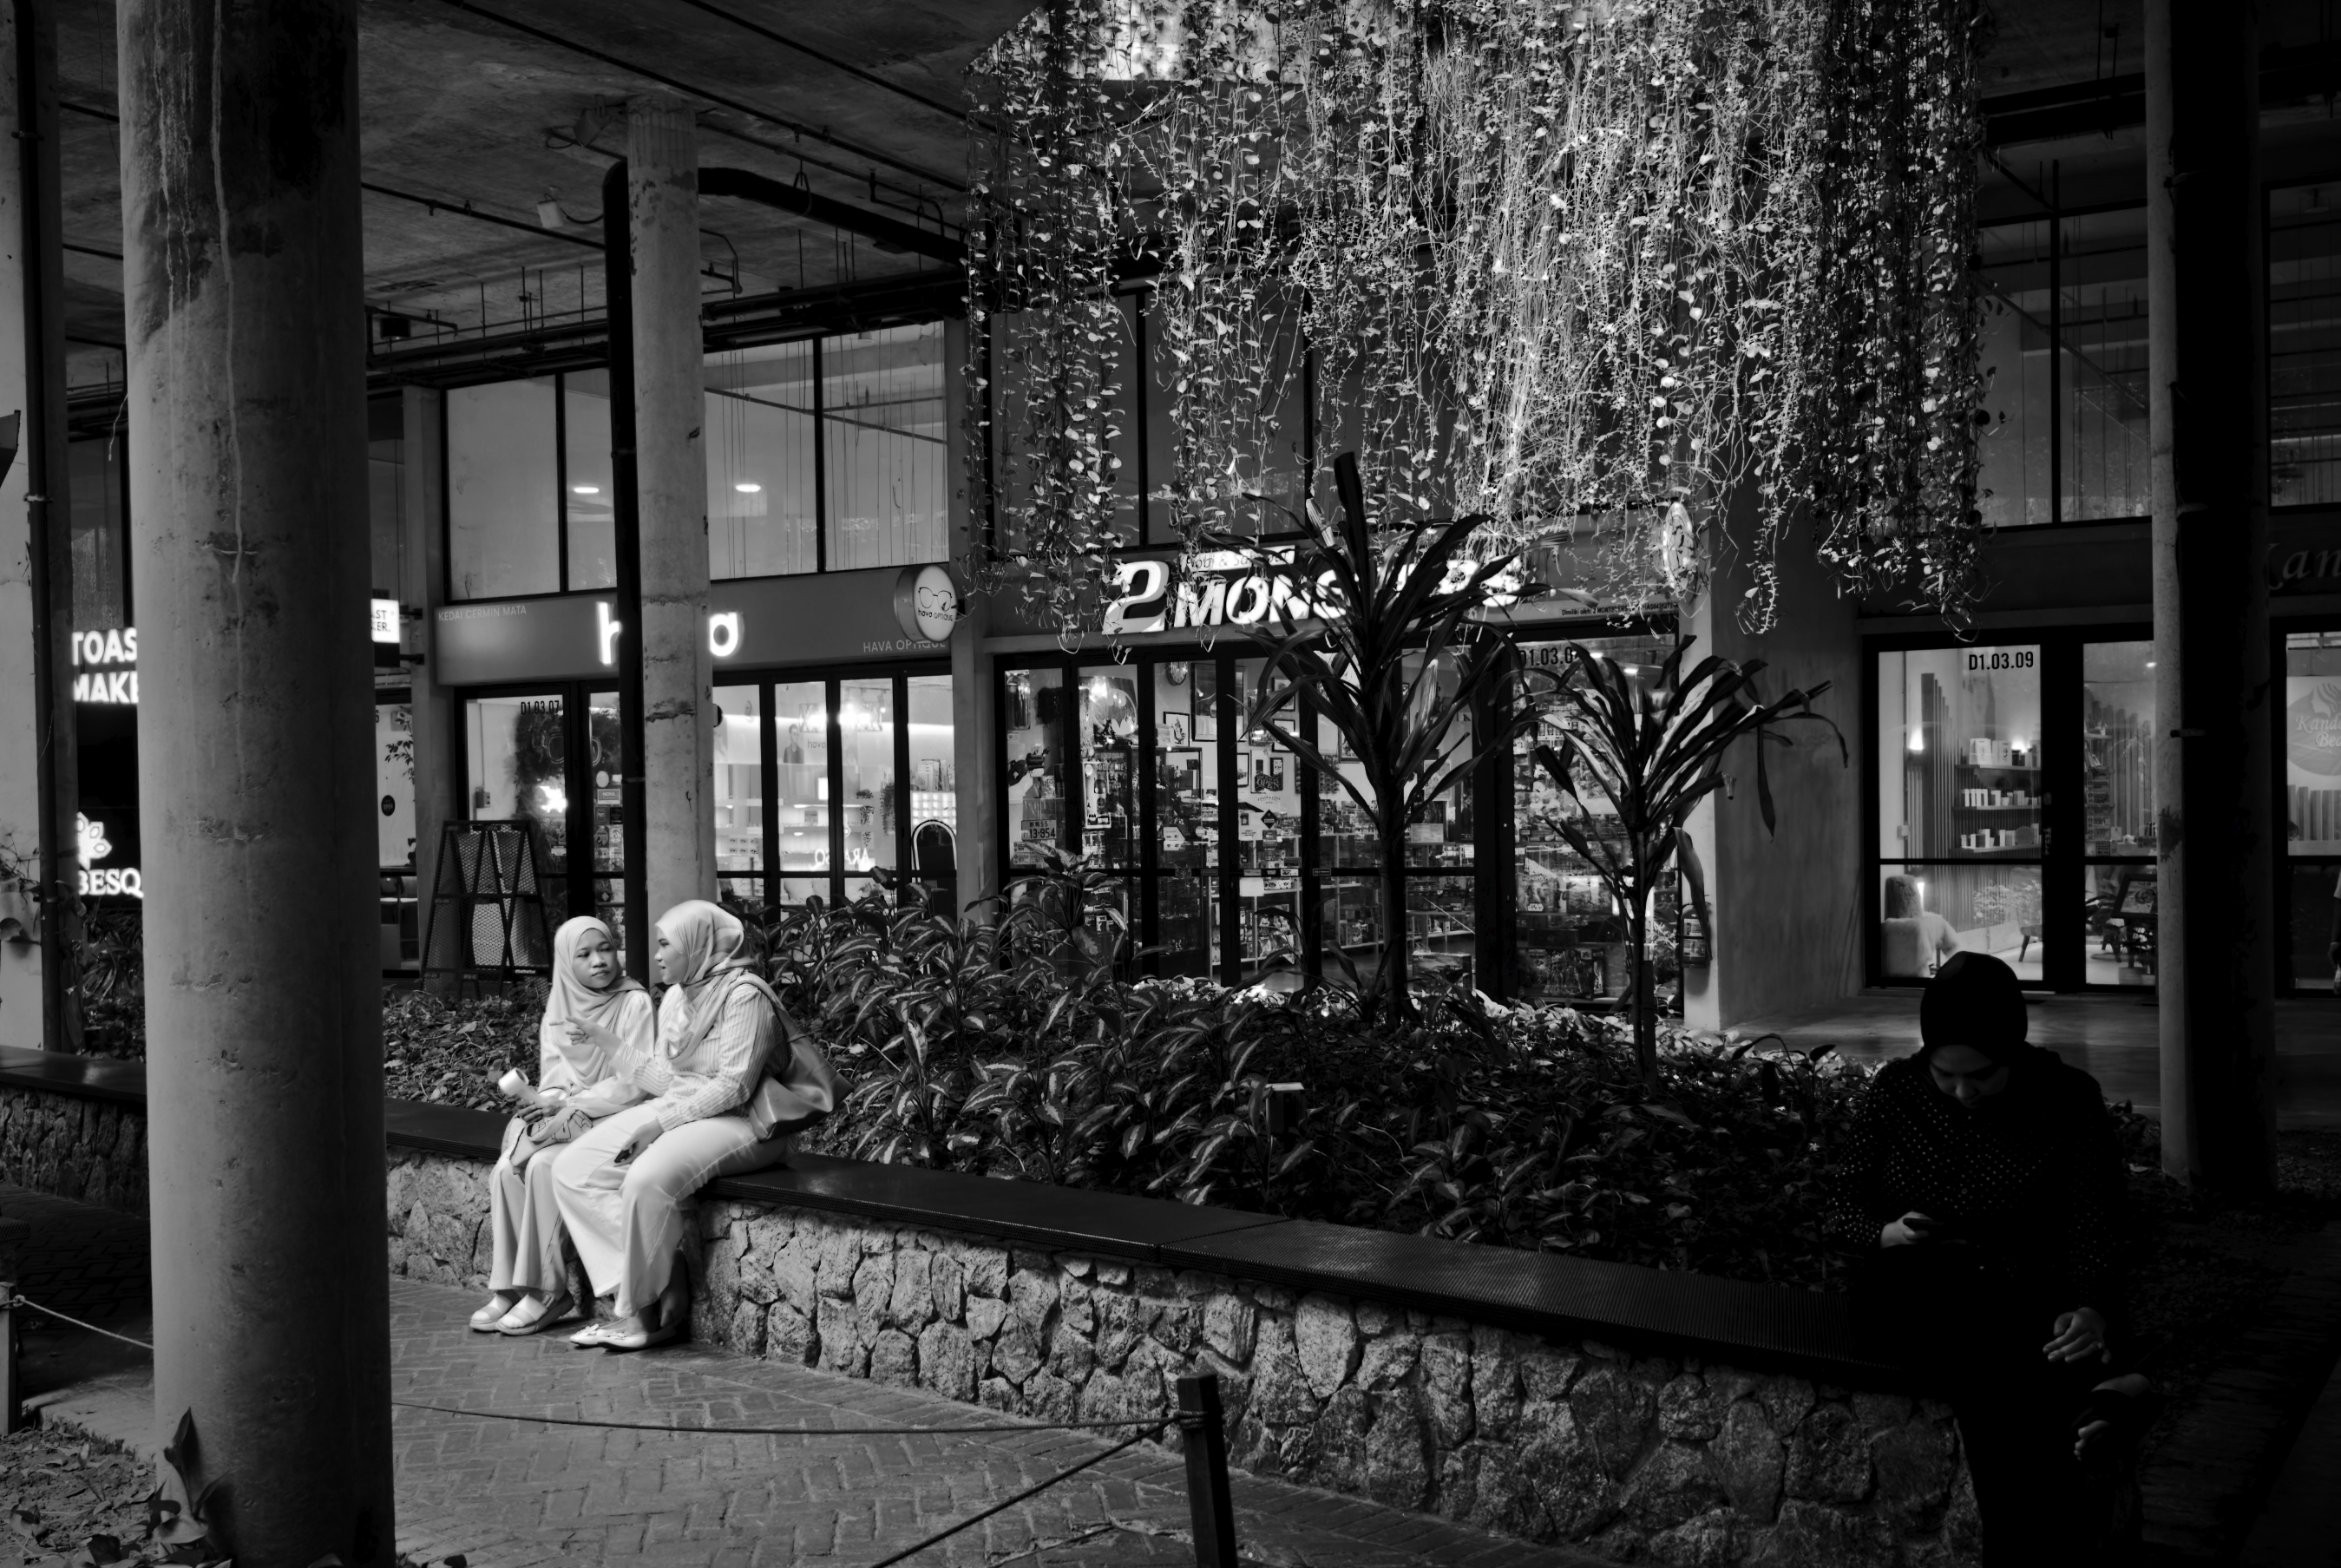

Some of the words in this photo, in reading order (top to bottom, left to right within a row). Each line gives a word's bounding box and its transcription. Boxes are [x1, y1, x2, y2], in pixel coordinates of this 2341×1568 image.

[1103, 560, 1170, 634] 2
[373, 609, 388, 620] ST
[502, 605, 527, 617] MATA
[863, 641, 893, 653] HAVA
[1969, 651, 2034, 670] D1.03.09
